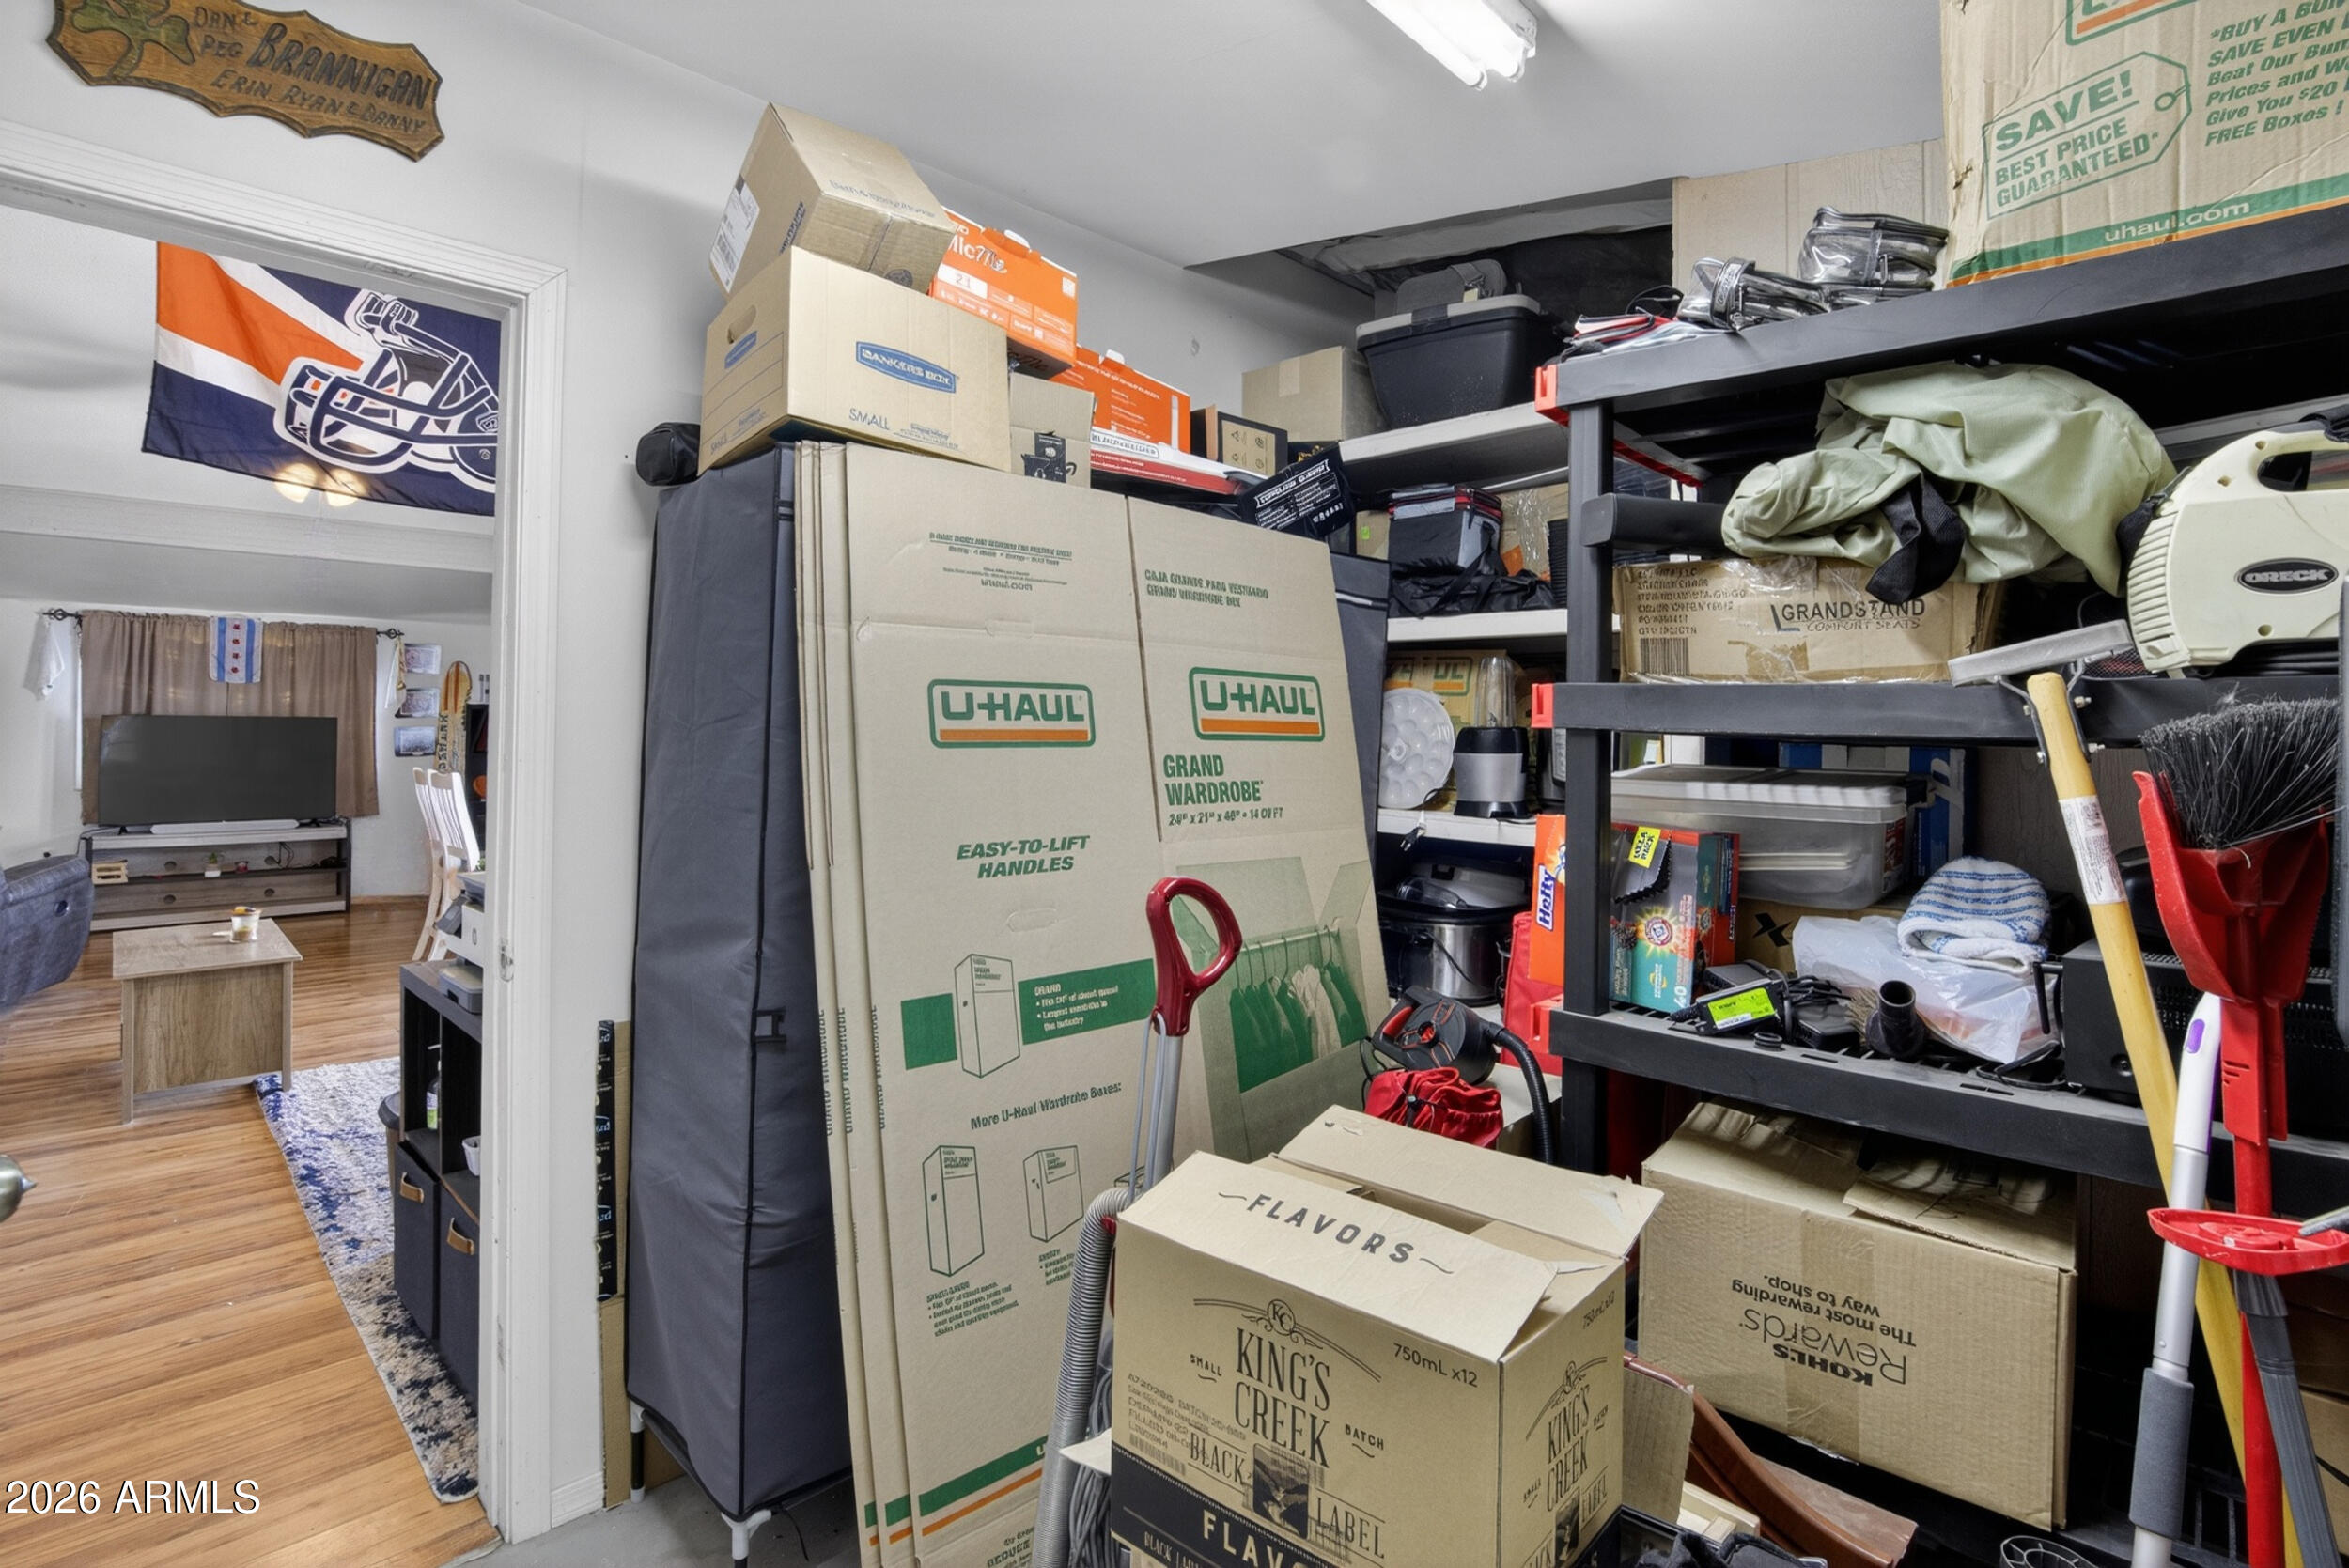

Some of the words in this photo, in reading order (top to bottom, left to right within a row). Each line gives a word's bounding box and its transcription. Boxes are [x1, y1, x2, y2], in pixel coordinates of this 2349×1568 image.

[2270, 8, 2286, 27] A
[2208, 37, 2267, 68] SAVE
[2272, 17, 2336, 49] EVEN
[200, 34, 243, 58] PEG
[246, 22, 432, 111] BRANNIGAN
[2207, 61, 2255, 87] Beat
[2260, 52, 2300, 72] Our
[2205, 80, 2271, 107] Prices
[2277, 64, 2320, 88] and
[283, 85, 340, 115] RYAN
[357, 103, 426, 133] DANNY
[1995, 70, 2135, 152] SAVE!
[2204, 120, 2258, 147] FREE
[2263, 106, 2329, 132] Boxes
[2206, 105, 2250, 127] Give
[2257, 95, 2294, 114] You
[1995, 151, 2048, 187] BEST
[2056, 117, 2128, 164] PRICE
[2104, 201, 2251, 243] uhaul.com
[848, 408, 890, 431] SMALL
[2244, 568, 2329, 583] ORECK
[1781, 598, 1926, 622] GRANDSTAND
[1807, 621, 1871, 633] COMFORT
[1875, 617, 1921, 630] SEATS
[941, 691, 1085, 722] U-HAUL
[1200, 679, 1315, 716] U-HAUL
[1163, 754, 1224, 778] GRAND
[1164, 781, 1262, 806] WARDROBE
[957, 834, 1091, 861] EASY-TO-LIFT
[977, 856, 1074, 879] HANDLES
[1539, 869, 1556, 926] Hefty
[971, 1115, 1000, 1129] More
[1247, 1193, 1414, 1264] FLAVORS
[1731, 1280, 1821, 1316] rewarding
[1763, 1273, 1813, 1300] shop.
[1816, 1290, 1837, 1305] to
[1826, 1310, 1875, 1330] most
[1841, 1296, 1880, 1317] way
[1744, 1308, 1907, 1386] Rewards
[1878, 1323, 1917, 1348] The
[1190, 1353, 1222, 1377] SMALL
[1237, 1327, 1330, 1411] KING'S
[1392, 1342, 1448, 1378] 750mL
[1451, 1367, 1480, 1389] x12
[1773, 1343, 1874, 1387] KOHL'S
[1235, 1381, 1330, 1468] CREEK
[1345, 1423, 1385, 1452] BATCH
[1548, 1383, 1590, 1464] KING'S
[1547, 1430, 1589, 1512] CREEK
[1190, 1431, 1248, 1489] BLACK
[1316, 1496, 1387, 1560] LABEL
[1203, 1509, 1308, 1568] FLAV
